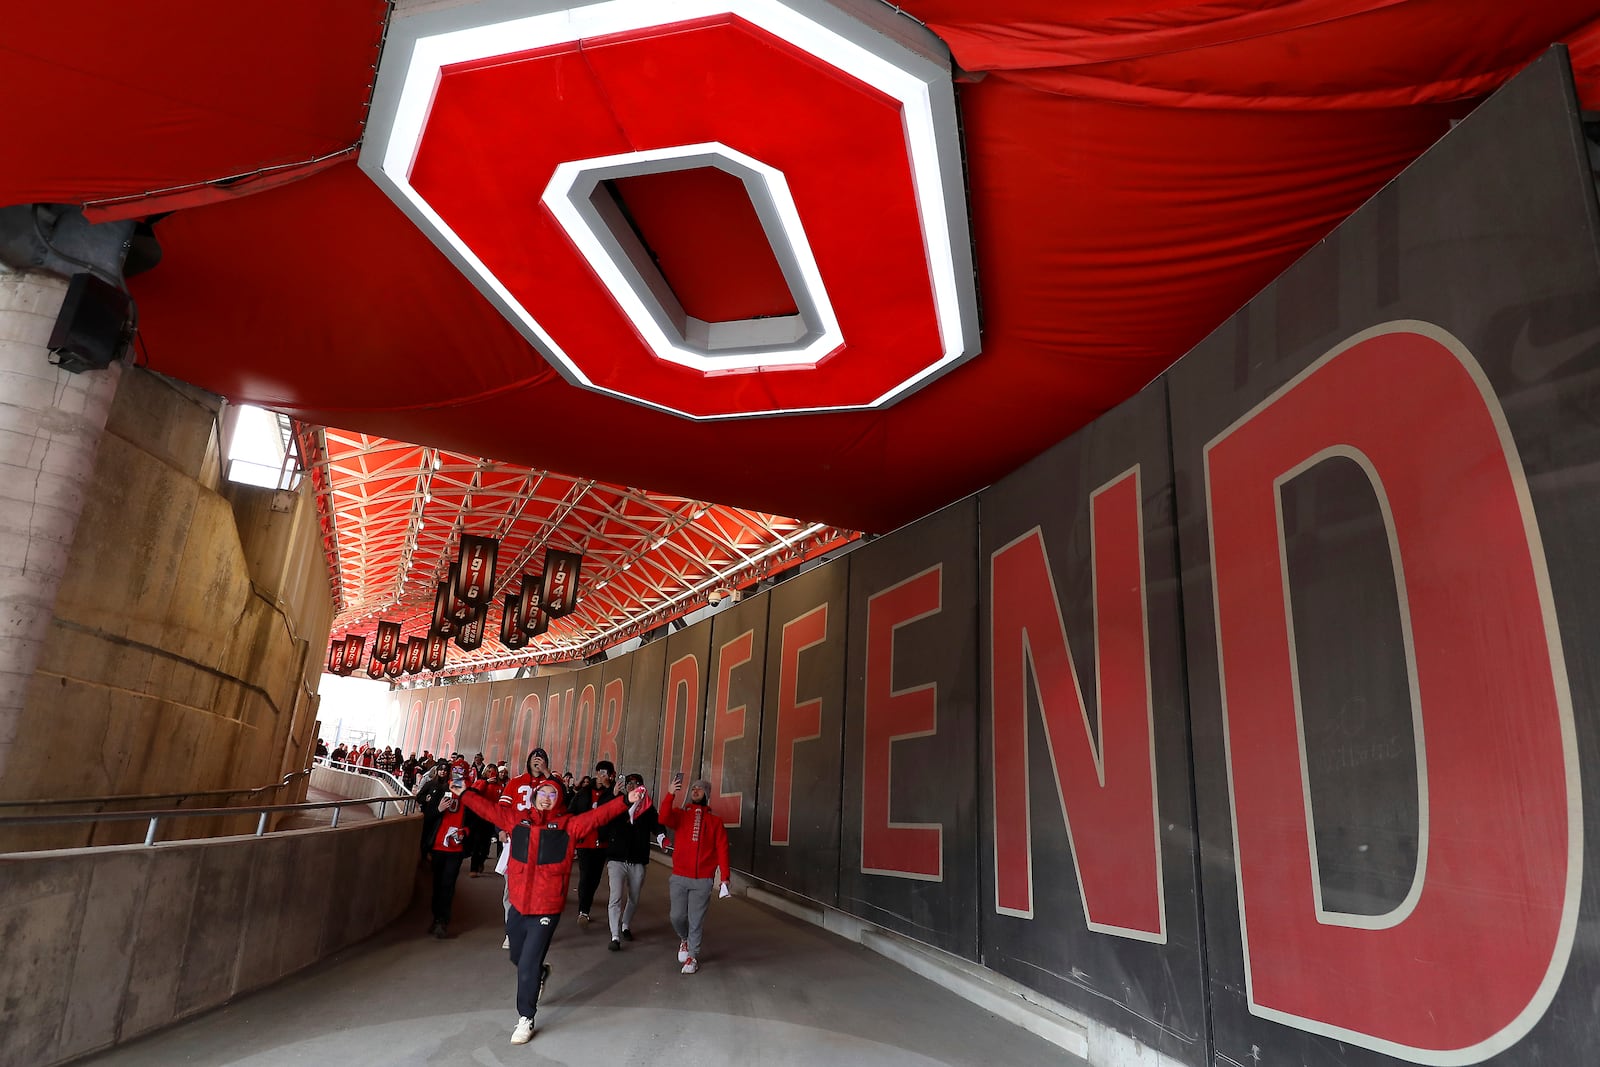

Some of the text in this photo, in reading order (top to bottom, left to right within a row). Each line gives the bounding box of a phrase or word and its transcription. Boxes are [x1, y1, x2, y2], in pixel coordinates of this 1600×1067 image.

[467, 545, 483, 599] 1916
[550, 559, 566, 610] 1944
[380, 627, 391, 659] 1942
[430, 637, 441, 667] 1954
[403, 697, 462, 760] OUR
[485, 678, 624, 780] HONOR
[660, 319, 1584, 1067] DEFEND
